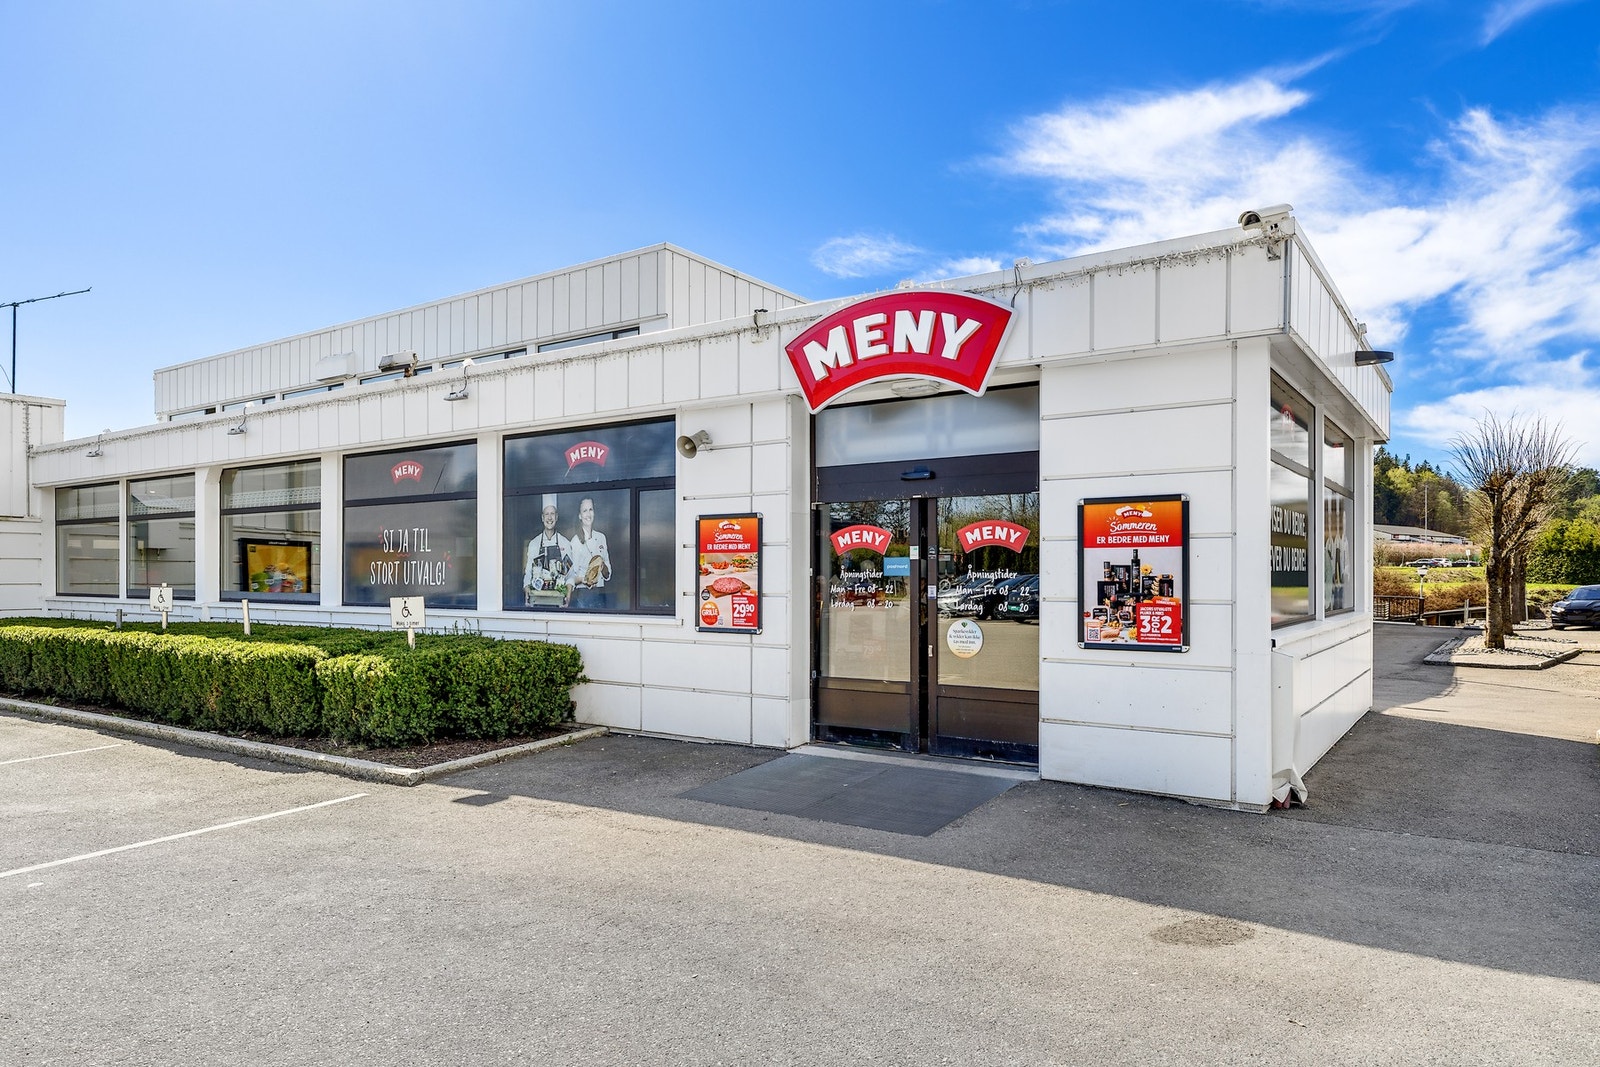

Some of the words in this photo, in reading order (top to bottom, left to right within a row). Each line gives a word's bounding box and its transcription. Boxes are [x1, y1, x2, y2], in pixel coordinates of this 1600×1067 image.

[803, 310, 982, 381] MENY
[570, 446, 605, 462] MENY
[394, 464, 420, 478] MENY
[1110, 521, 1157, 532] Sommeren
[383, 529, 394, 553] SI
[397, 529, 409, 553] JA
[413, 527, 431, 552] TIL
[714, 532, 743, 541] Sommeren
[837, 530, 885, 548] MENY
[965, 525, 1022, 545] MENY
[1096, 536, 1106, 544] ER
[1108, 535, 1132, 544] BEDRE
[1132, 535, 1148, 543] MED
[1148, 535, 1170, 543] MENY
[370, 560, 400, 585] STORT
[403, 560, 446, 586] UTVALG!
[840, 565, 883, 582] Åpningstider
[966, 564, 1017, 582] Åpningstider
[830, 584, 846, 594] Man
[854, 583, 865, 594] Fre
[867, 583, 876, 593] 08
[885, 584, 893, 594] 22
[955, 585, 973, 595] Man
[983, 585, 997, 596] Fre
[999, 585, 1009, 596] 08
[1020, 586, 1030, 596] 22
[830, 599, 855, 611] Lørdag
[867, 599, 875, 609] 08
[885, 599, 893, 609] 20
[955, 600, 983, 615] Lørdag
[998, 601, 1008, 612] 08
[1019, 602, 1029, 612] 20
[1140, 615, 1151, 633] 3
[1151, 615, 1160, 633] FOR
[1161, 615, 1172, 634] 2
